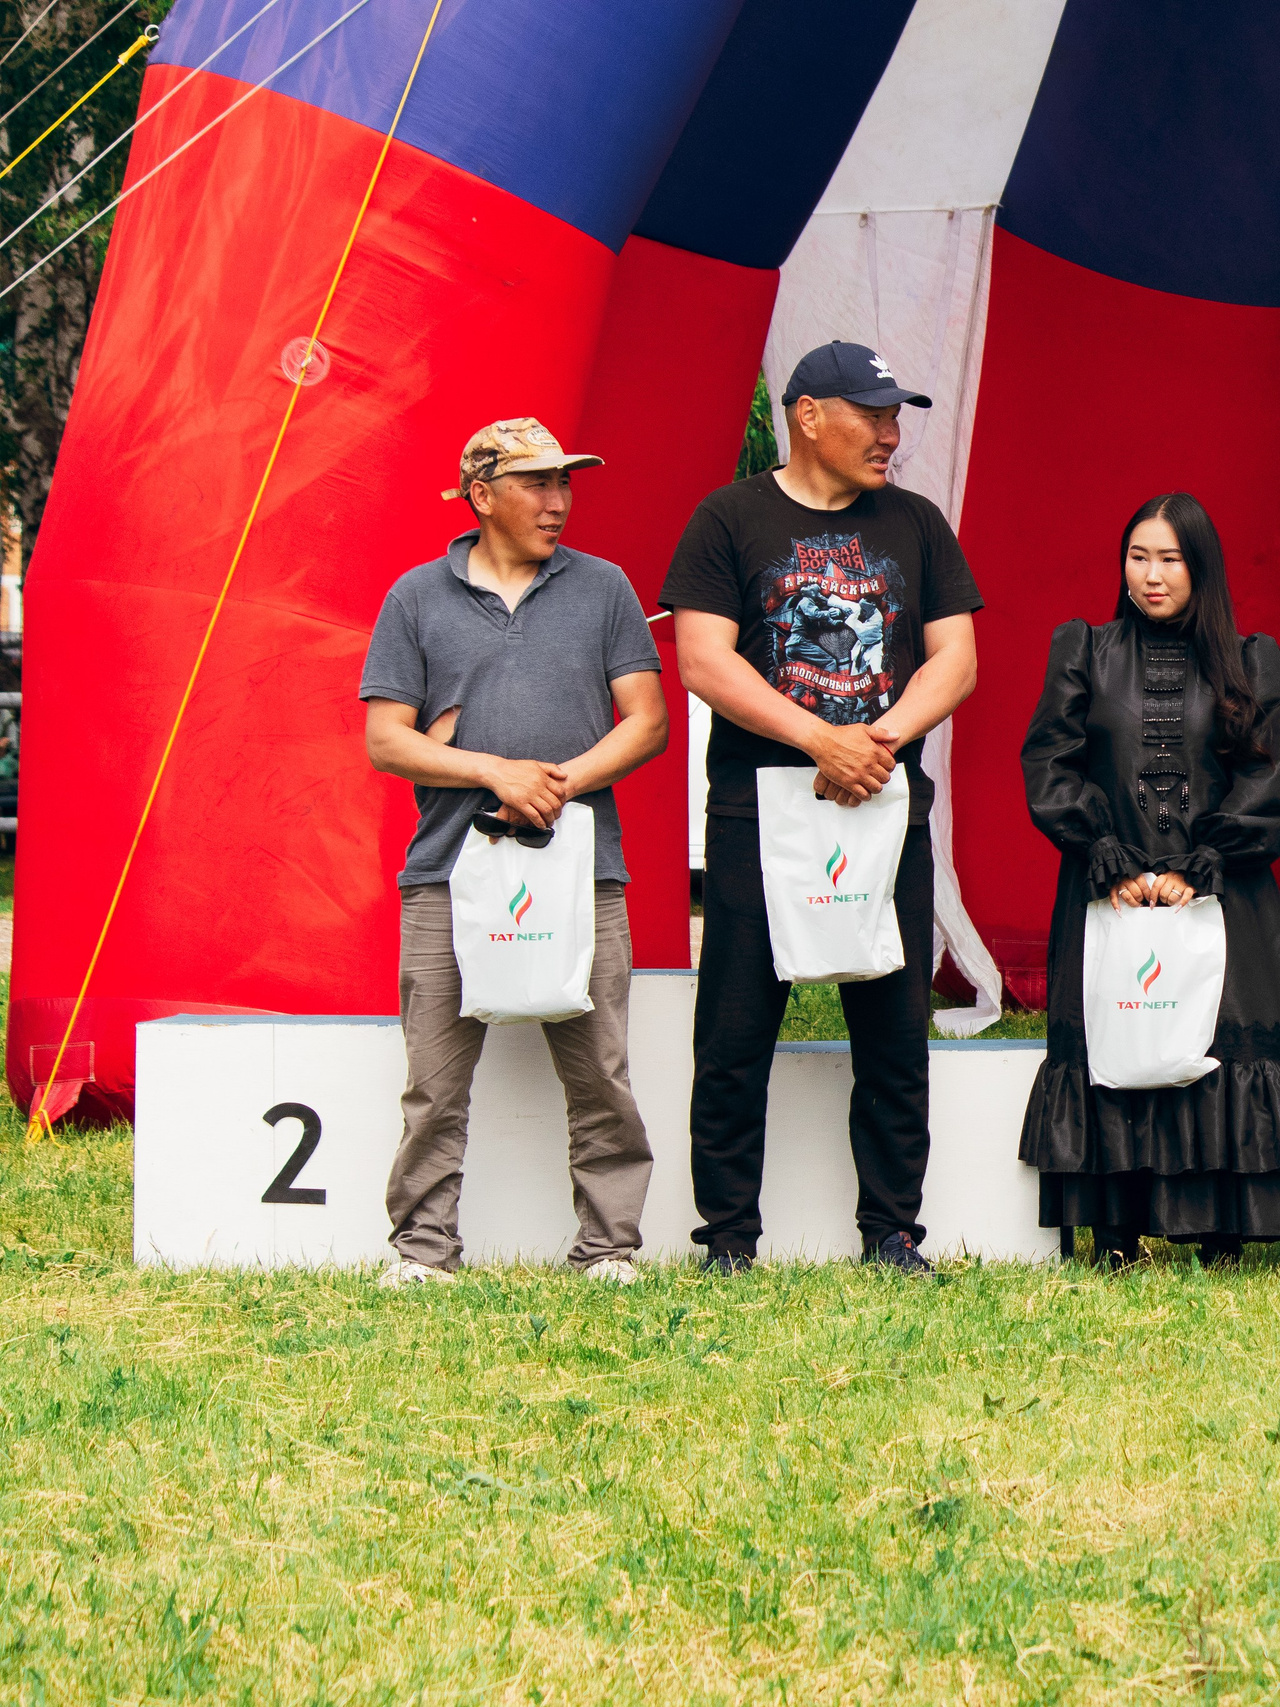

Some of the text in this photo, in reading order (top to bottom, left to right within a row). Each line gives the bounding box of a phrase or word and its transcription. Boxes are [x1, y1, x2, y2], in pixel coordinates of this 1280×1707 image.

[795, 537, 861, 559] БОЕВАЯ
[784, 575, 880, 595] АРМЕЙСКИЙ
[779, 667, 872, 692] РУКОПАШНЫЙ БОЙ
[260, 1102, 327, 1205] 2
